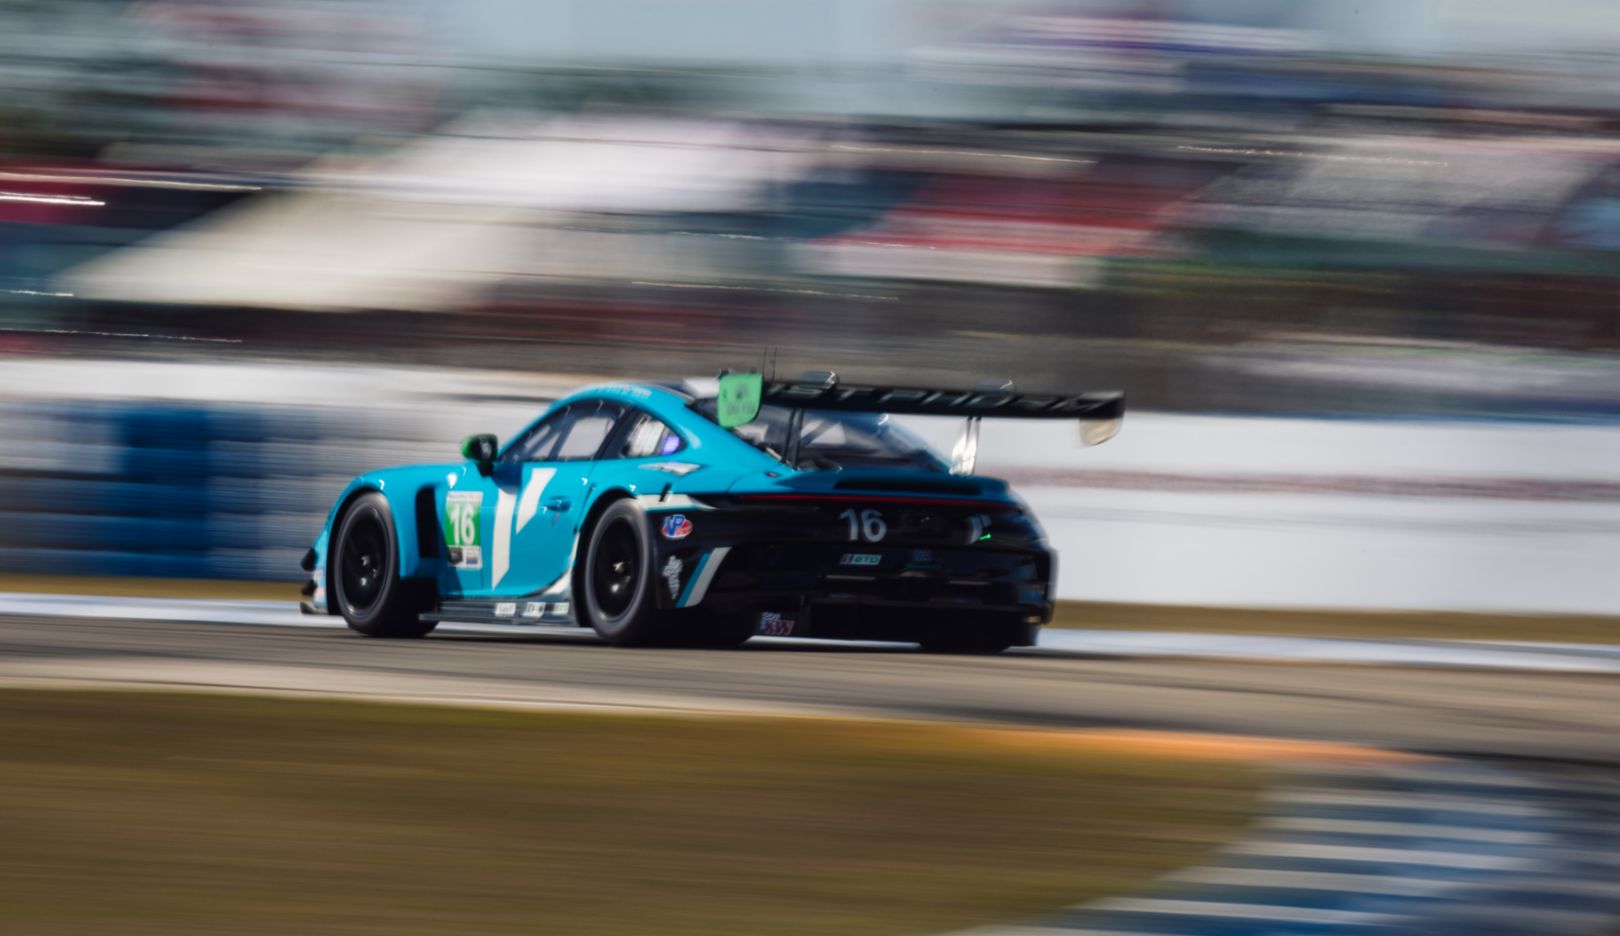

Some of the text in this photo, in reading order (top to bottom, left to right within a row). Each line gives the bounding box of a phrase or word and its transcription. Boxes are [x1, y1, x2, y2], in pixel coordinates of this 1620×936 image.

[448, 499, 475, 545] 16
[663, 513, 687, 536] VP
[839, 509, 887, 543] 16
